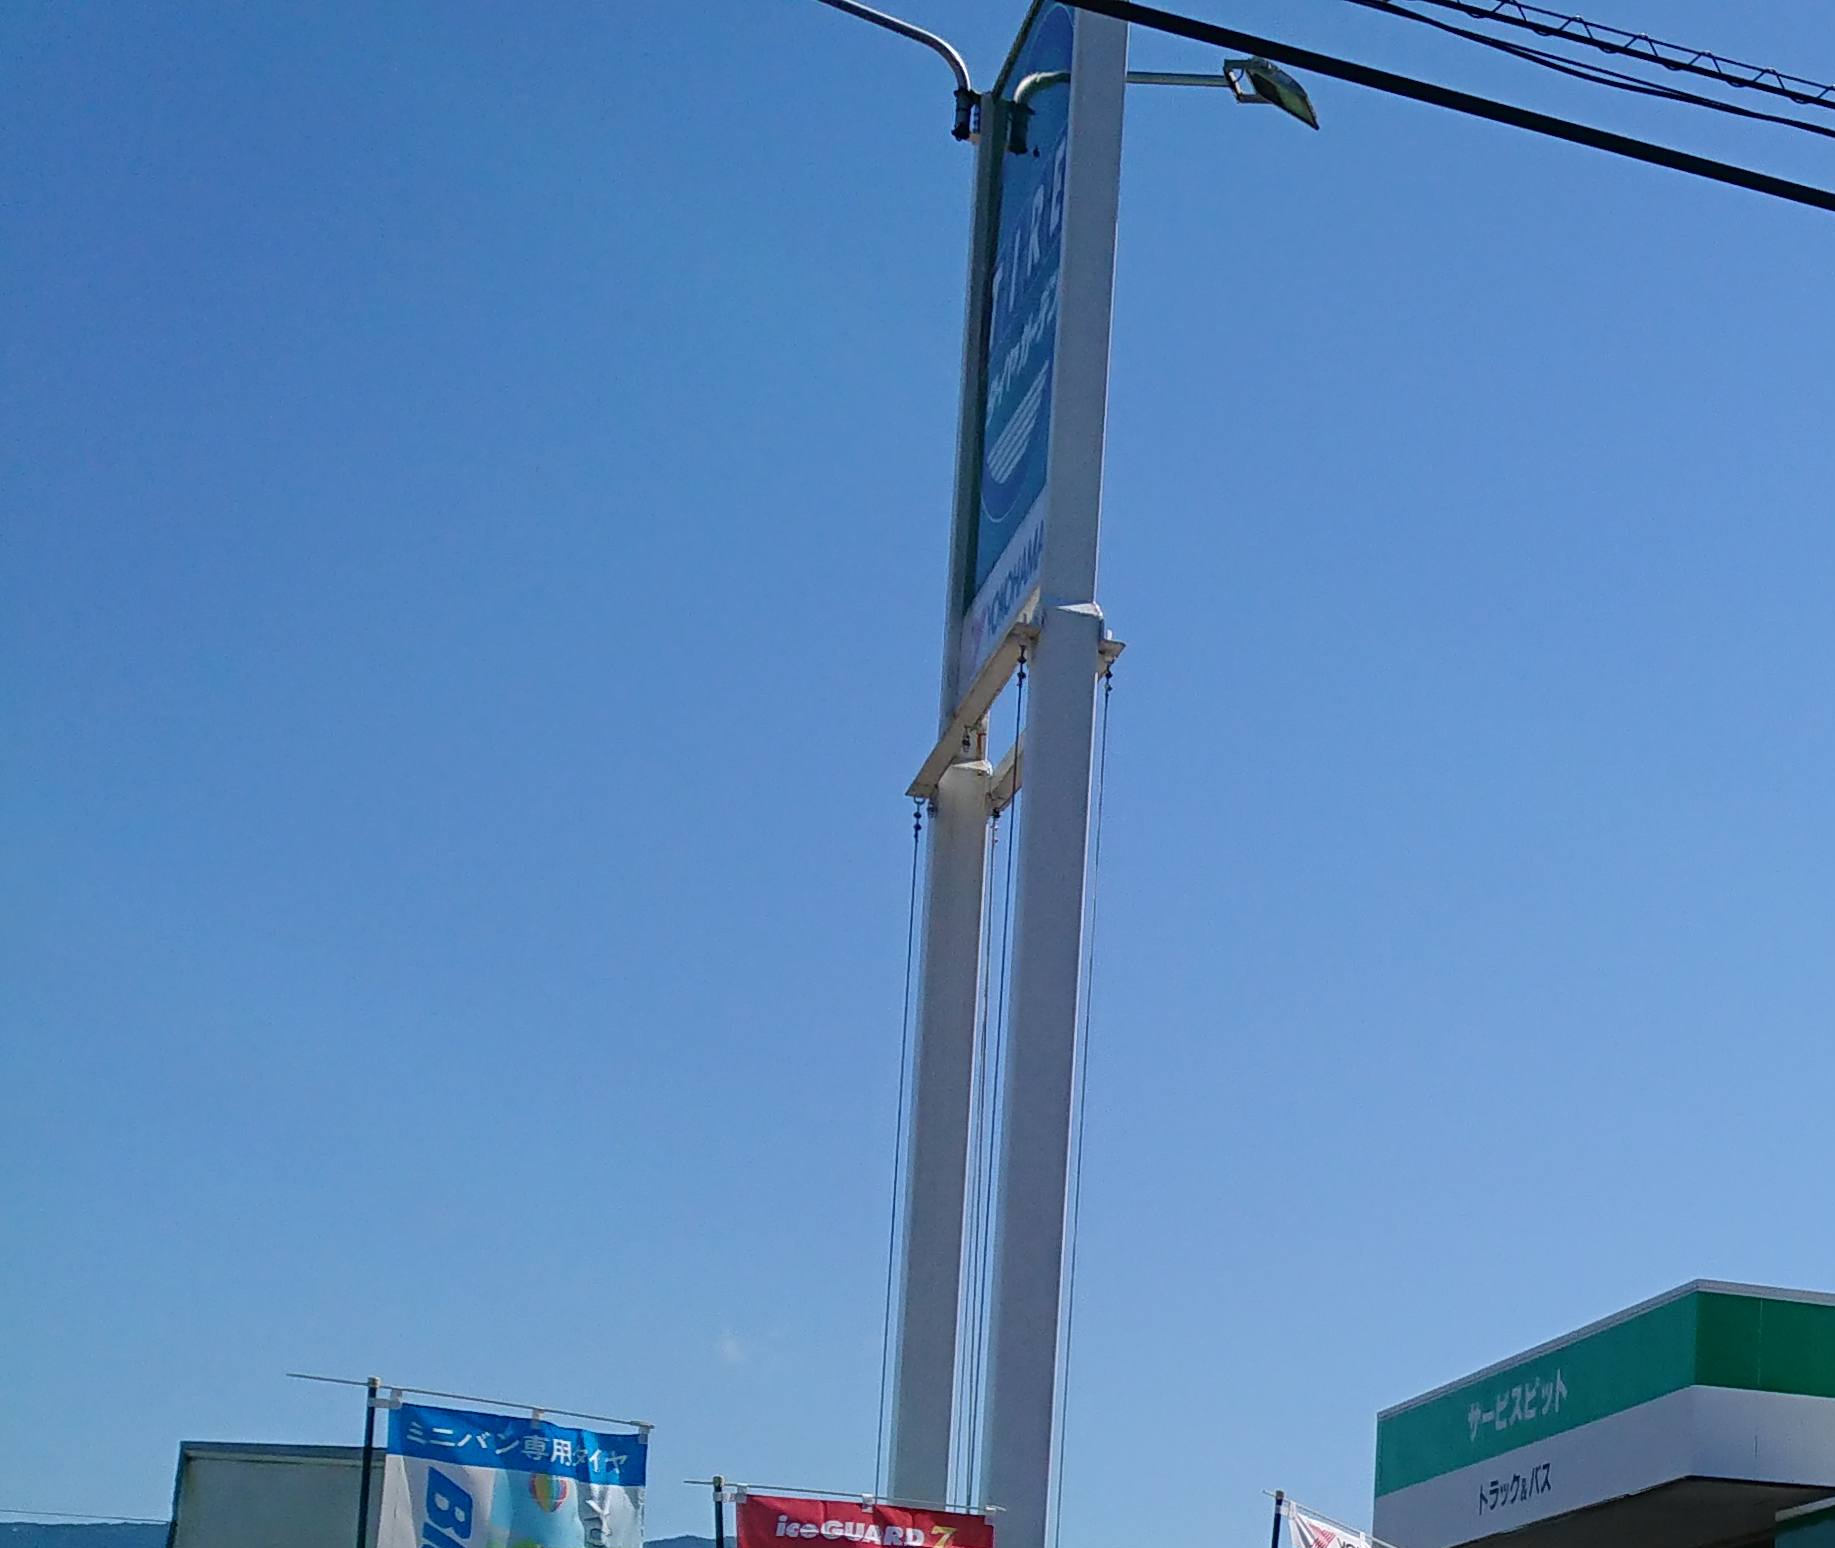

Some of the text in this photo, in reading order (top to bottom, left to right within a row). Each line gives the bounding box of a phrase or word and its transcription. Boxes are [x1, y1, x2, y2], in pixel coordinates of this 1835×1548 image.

[1468, 1369, 1568, 1442] サービスピット
[406, 1420, 629, 1475] ミニバン専用タイヤ
[1479, 1463, 1552, 1516] トラック&バス
[775, 1514, 926, 1547] iceGUARD
